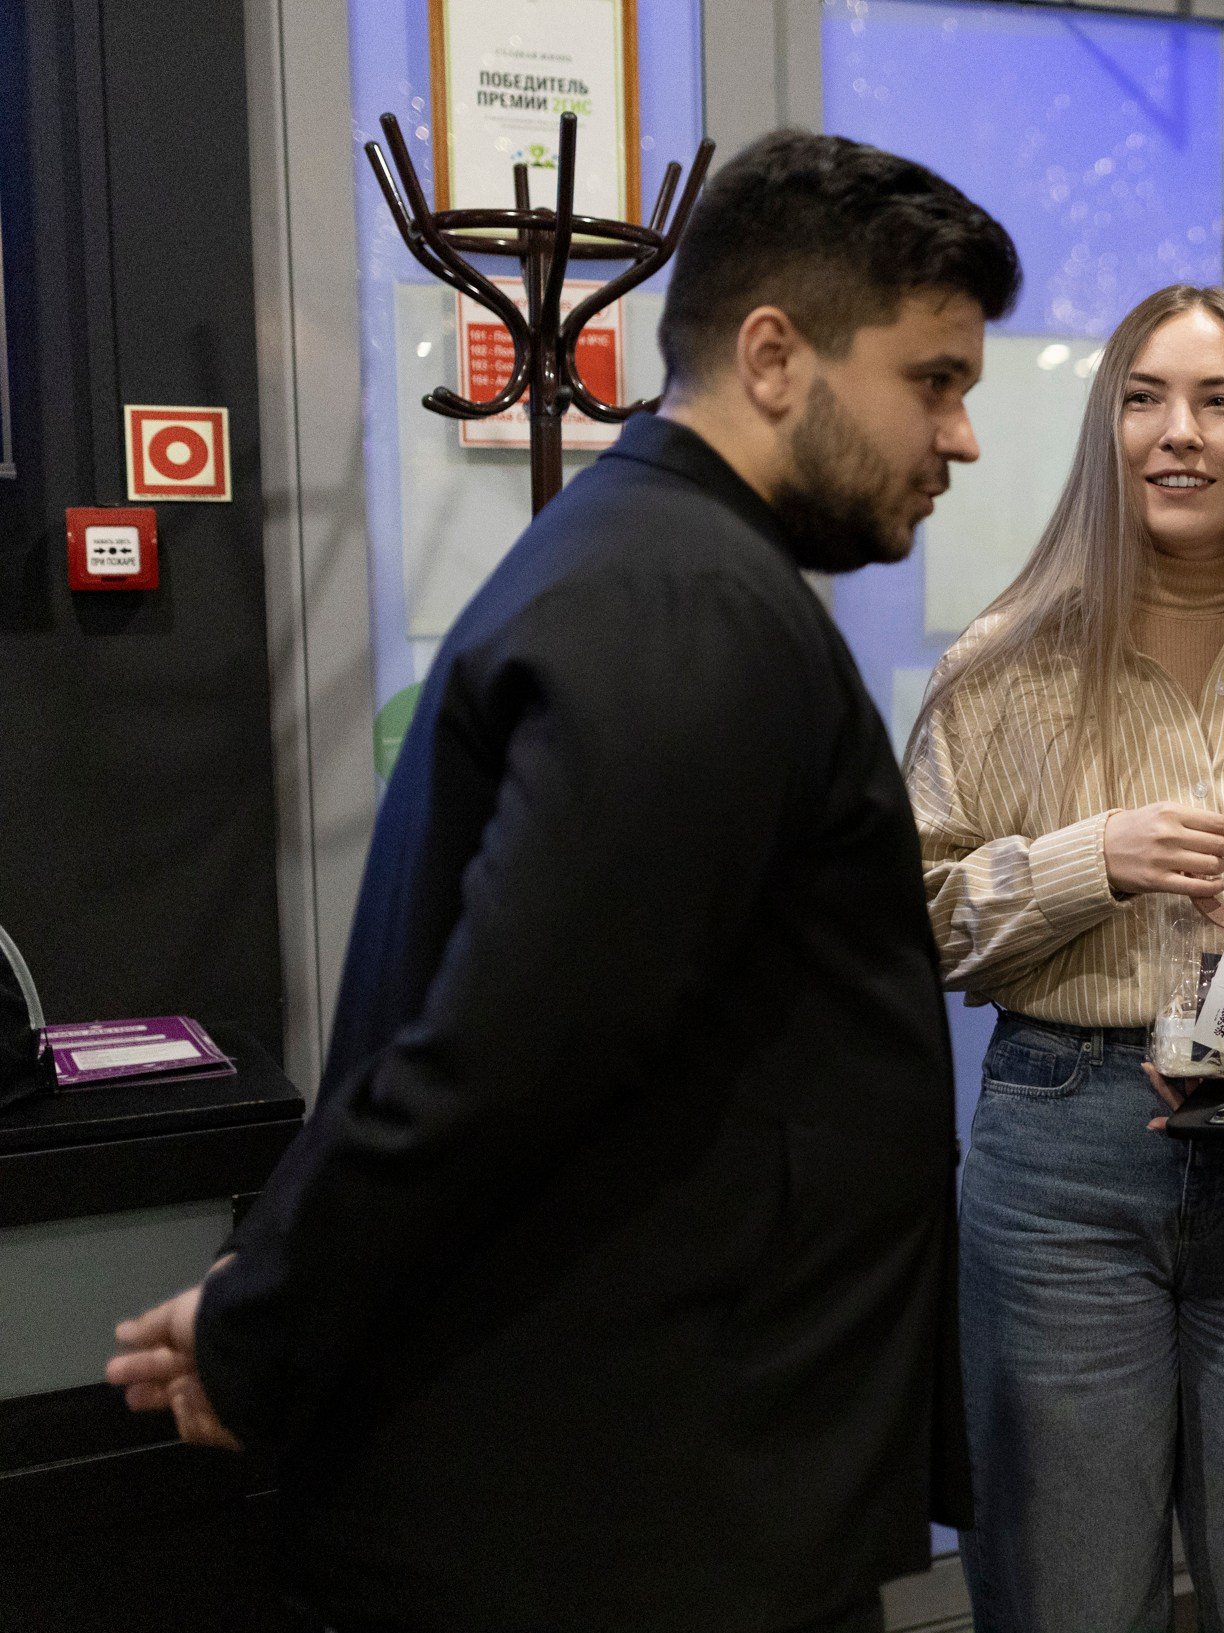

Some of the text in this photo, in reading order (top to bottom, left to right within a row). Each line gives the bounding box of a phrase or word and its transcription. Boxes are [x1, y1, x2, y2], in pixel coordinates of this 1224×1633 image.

[479, 70, 589, 95] ПОБЕДИТЕЛЬ
[477, 90, 592, 116] ПРЕМИИ 2ГИС
[91, 557, 136, 567] ПРИ ПОЖАРЕ
